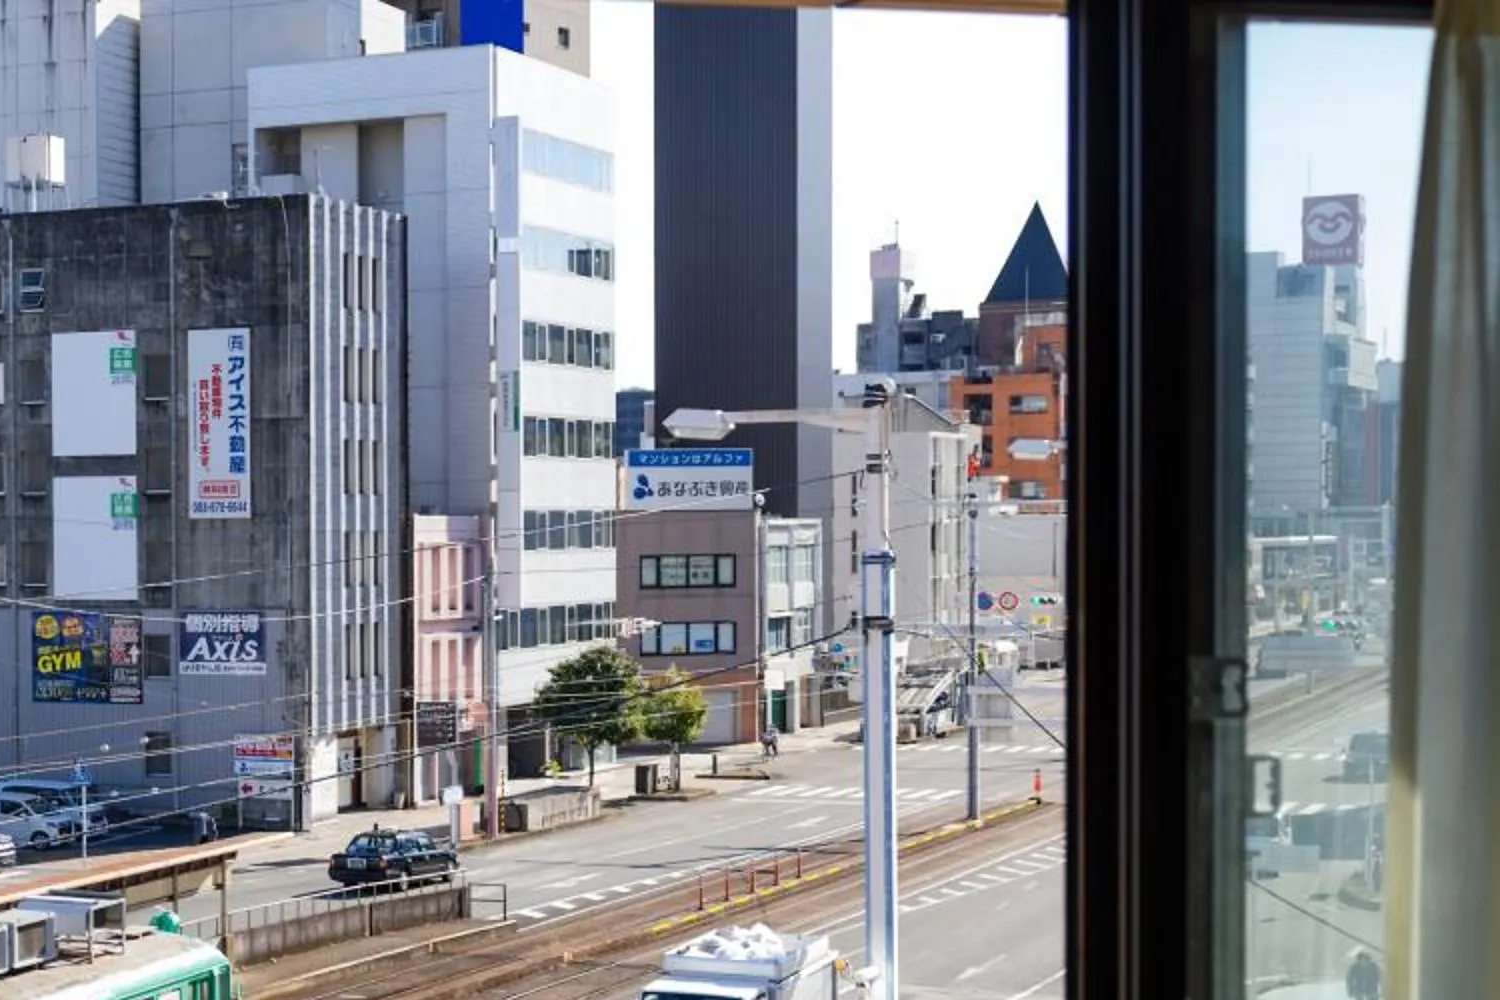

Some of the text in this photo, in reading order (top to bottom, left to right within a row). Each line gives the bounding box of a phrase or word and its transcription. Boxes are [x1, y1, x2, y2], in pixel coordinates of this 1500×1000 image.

[638, 453, 744, 465] マンションはアルファ
[656, 480, 749, 498] あなぶき興産
[186, 633, 260, 662] Axis
[37, 650, 82, 673] GYM
